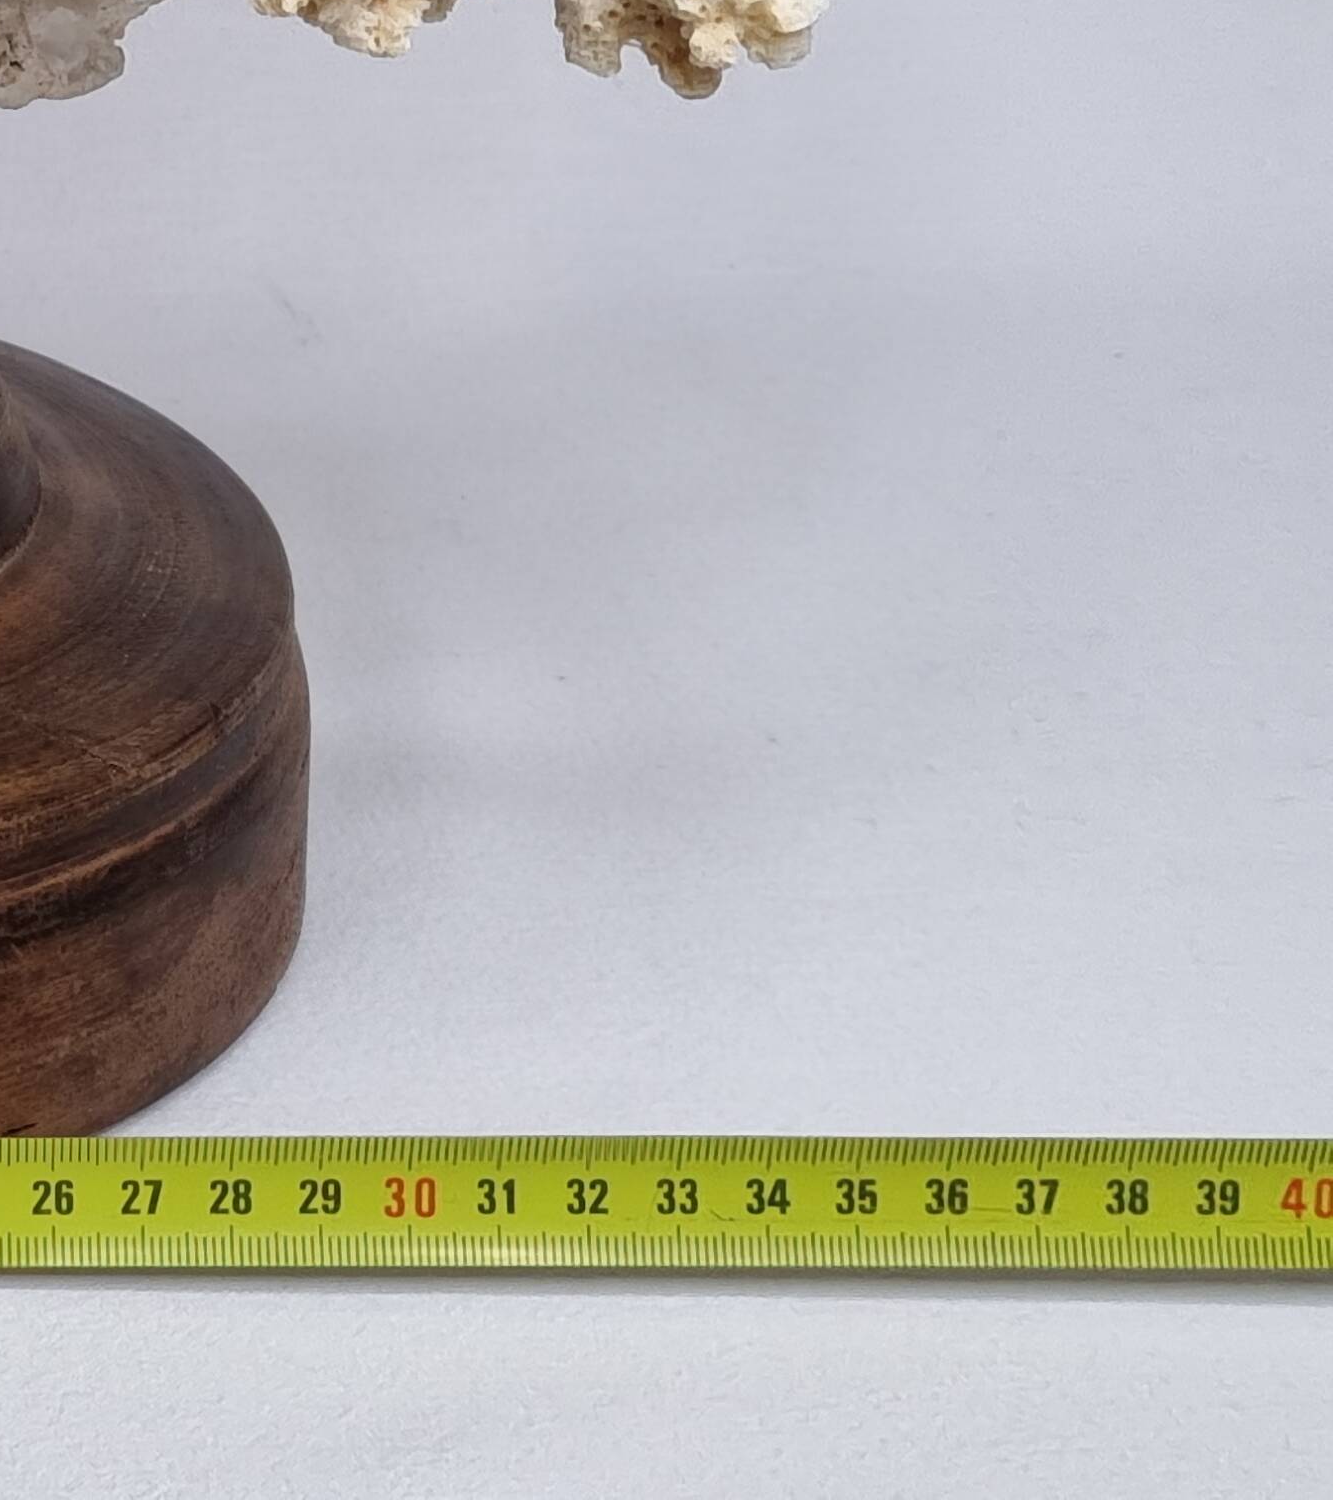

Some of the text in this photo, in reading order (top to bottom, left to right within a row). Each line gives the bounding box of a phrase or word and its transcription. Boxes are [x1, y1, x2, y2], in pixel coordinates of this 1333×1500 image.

[32, 1179, 74, 1216] 26
[121, 1179, 163, 1215] 27
[209, 1178, 252, 1215] 28
[299, 1178, 342, 1215] 29
[384, 1176, 438, 1219] 30
[477, 1178, 515, 1215] 31
[566, 1178, 609, 1215] 32
[656, 1178, 699, 1215] 33
[746, 1178, 791, 1215] 34
[835, 1178, 878, 1215] 35
[925, 1178, 969, 1215] 36
[1016, 1178, 1059, 1215] 37
[1105, 1178, 1149, 1215] 38
[1196, 1179, 1240, 1216] 39
[1280, 1177, 1333, 1219] 40
